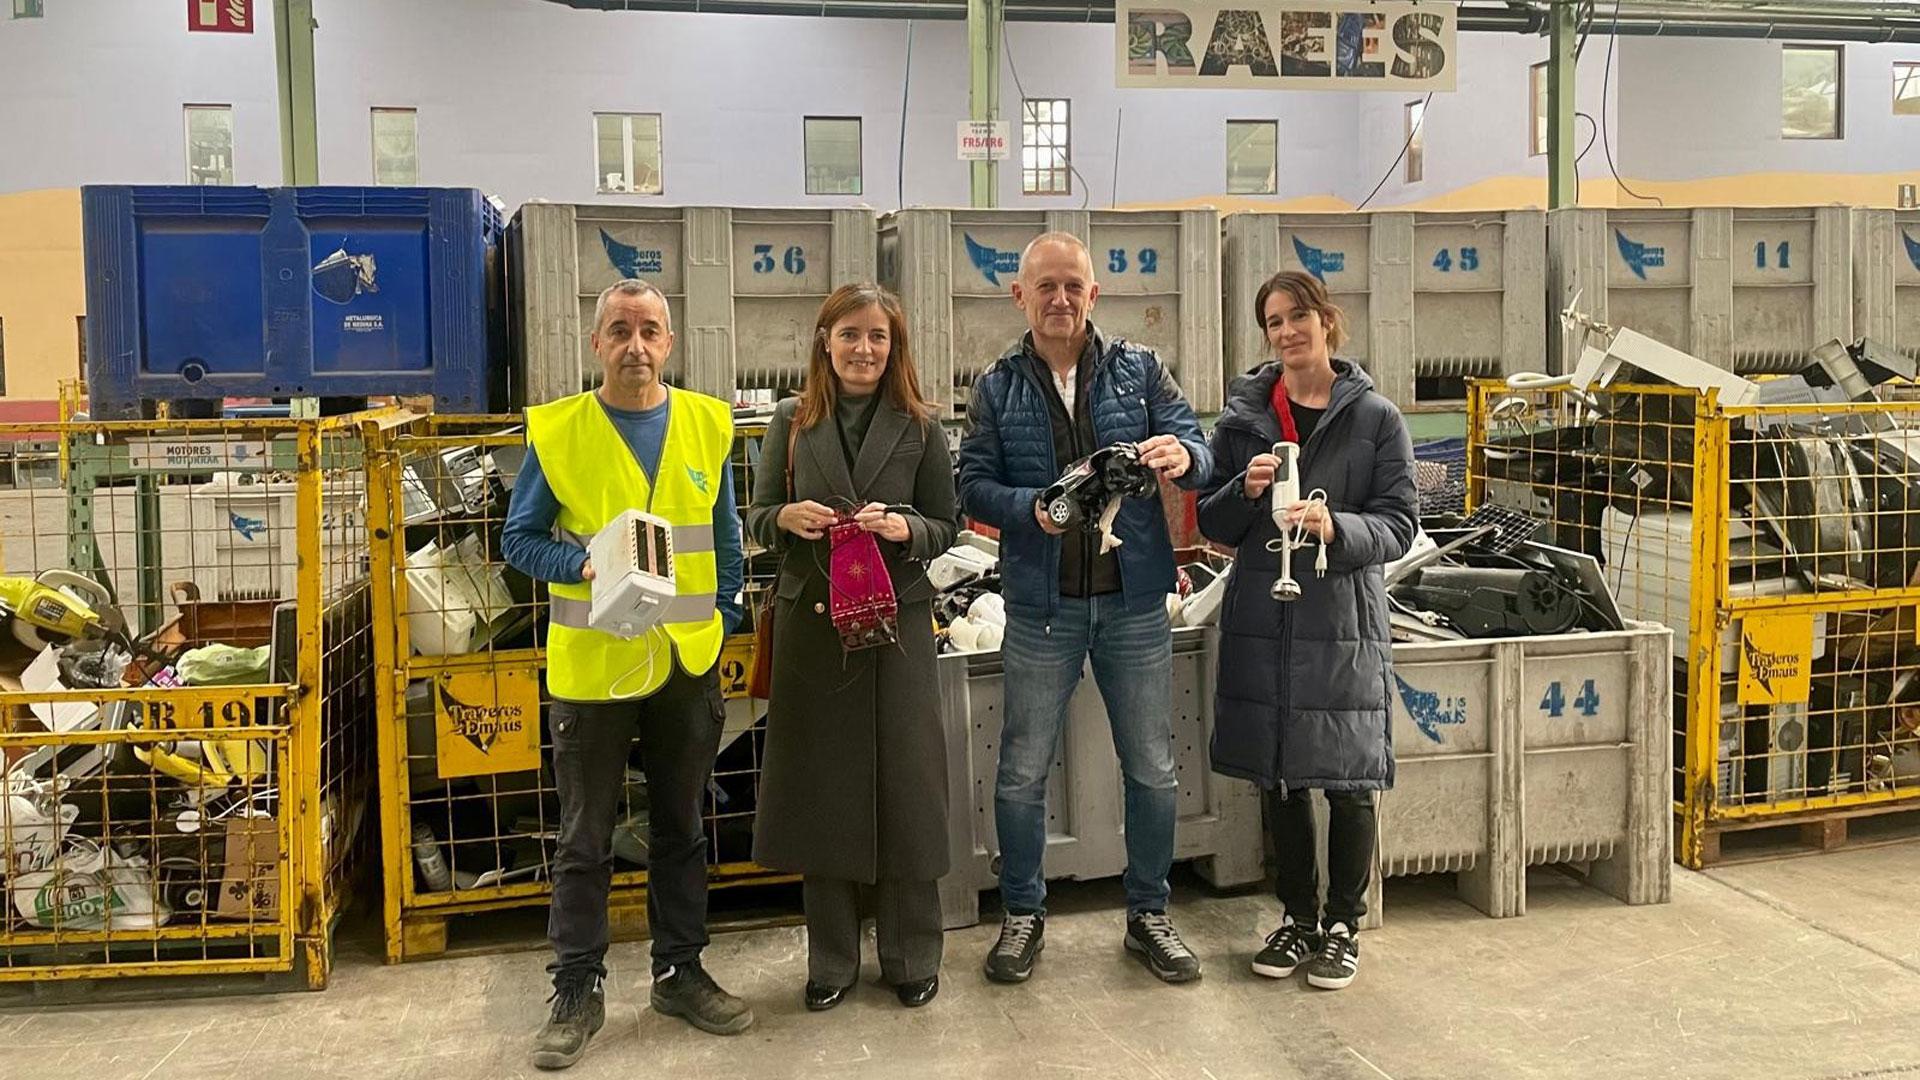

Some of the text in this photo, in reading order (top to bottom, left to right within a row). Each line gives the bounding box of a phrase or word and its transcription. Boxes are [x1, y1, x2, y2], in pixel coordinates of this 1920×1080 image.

[1128, 10, 1446, 78] RAEES
[753, 245, 806, 275] 36
[1108, 248, 1157, 274] 52
[1433, 247, 1479, 272] 45
[1753, 241, 1790, 269] 11
[166, 446, 212, 455] MOTORES
[1539, 679, 1601, 718] 44
